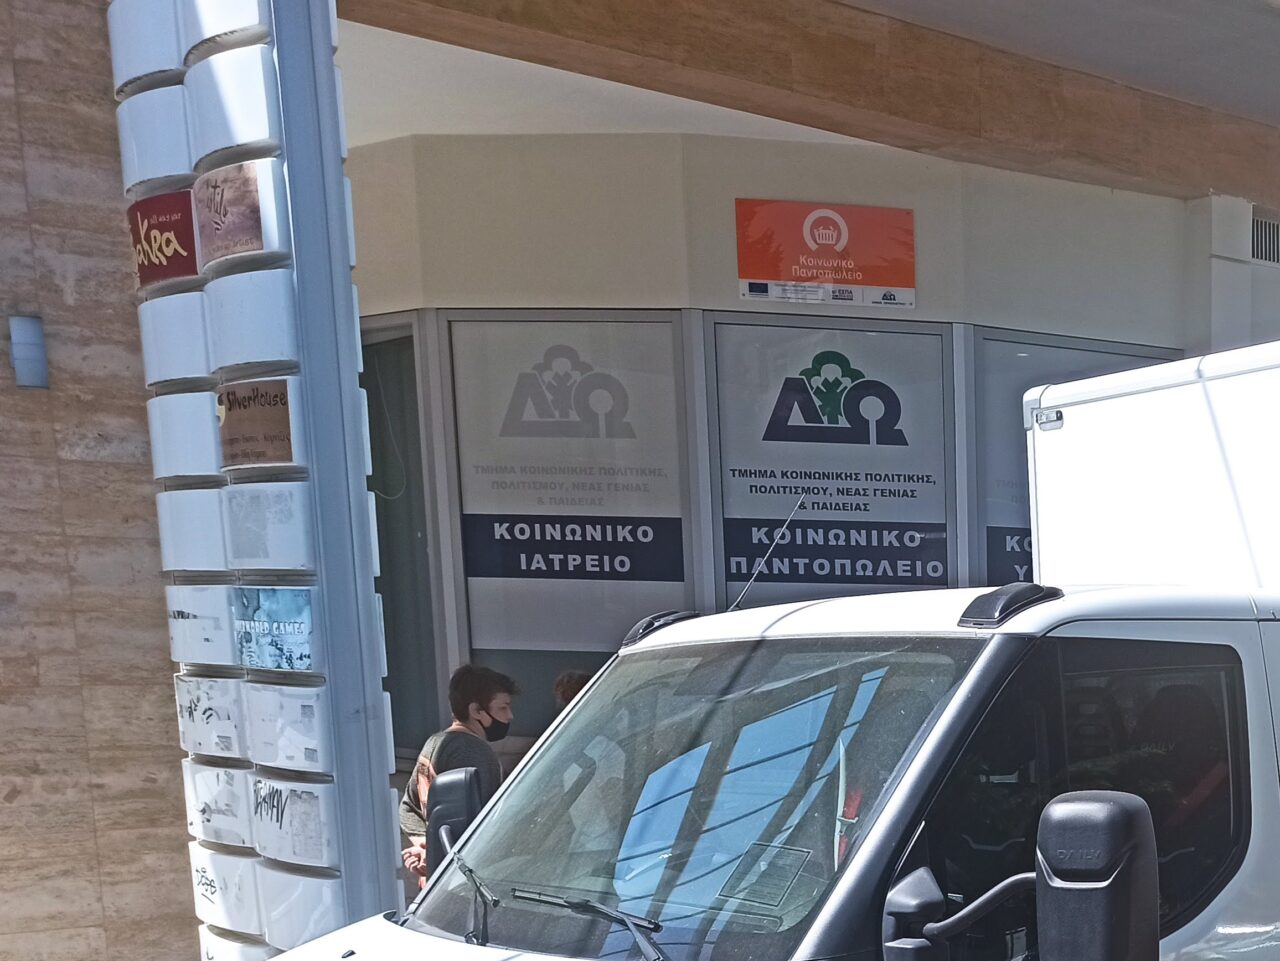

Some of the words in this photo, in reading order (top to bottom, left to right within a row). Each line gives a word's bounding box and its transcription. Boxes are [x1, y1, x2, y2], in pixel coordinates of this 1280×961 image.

[473, 465, 516, 475] ΤΜΗΜΑ
[519, 465, 596, 476] ΚΟΙΝΩΝΙΚΗΣ
[729, 468, 777, 479] ΤΜΗΜΑ
[780, 470, 861, 482] ΚΟΙΝΩΝΙΚΗΣ
[864, 472, 936, 485] ΠΟΛΙΤΙΚΗΣ,
[572, 482, 604, 492] ΝΕΑΣ
[606, 482, 650, 493] ΓΕΝΙΑΣ
[749, 484, 833, 498] ΠΟΛΙΤΙΣΜΟΥ,
[836, 487, 870, 497] ΝΕΑΣ
[873, 487, 917, 498] ΓΕΝΙΑΣ
[811, 502, 870, 512] ΠΑΙΔΕΙΑΣ
[493, 522, 654, 543] ΚΟΙΝΩΝΙΚΟ
[751, 527, 921, 547] ΚΟΙΝΩΝΙΚΟ
[519, 553, 632, 572] ΙΑΤΡΕΙΟ
[730, 556, 944, 577] ΠΑΝΤΟΠΩΛΕΙΟ
